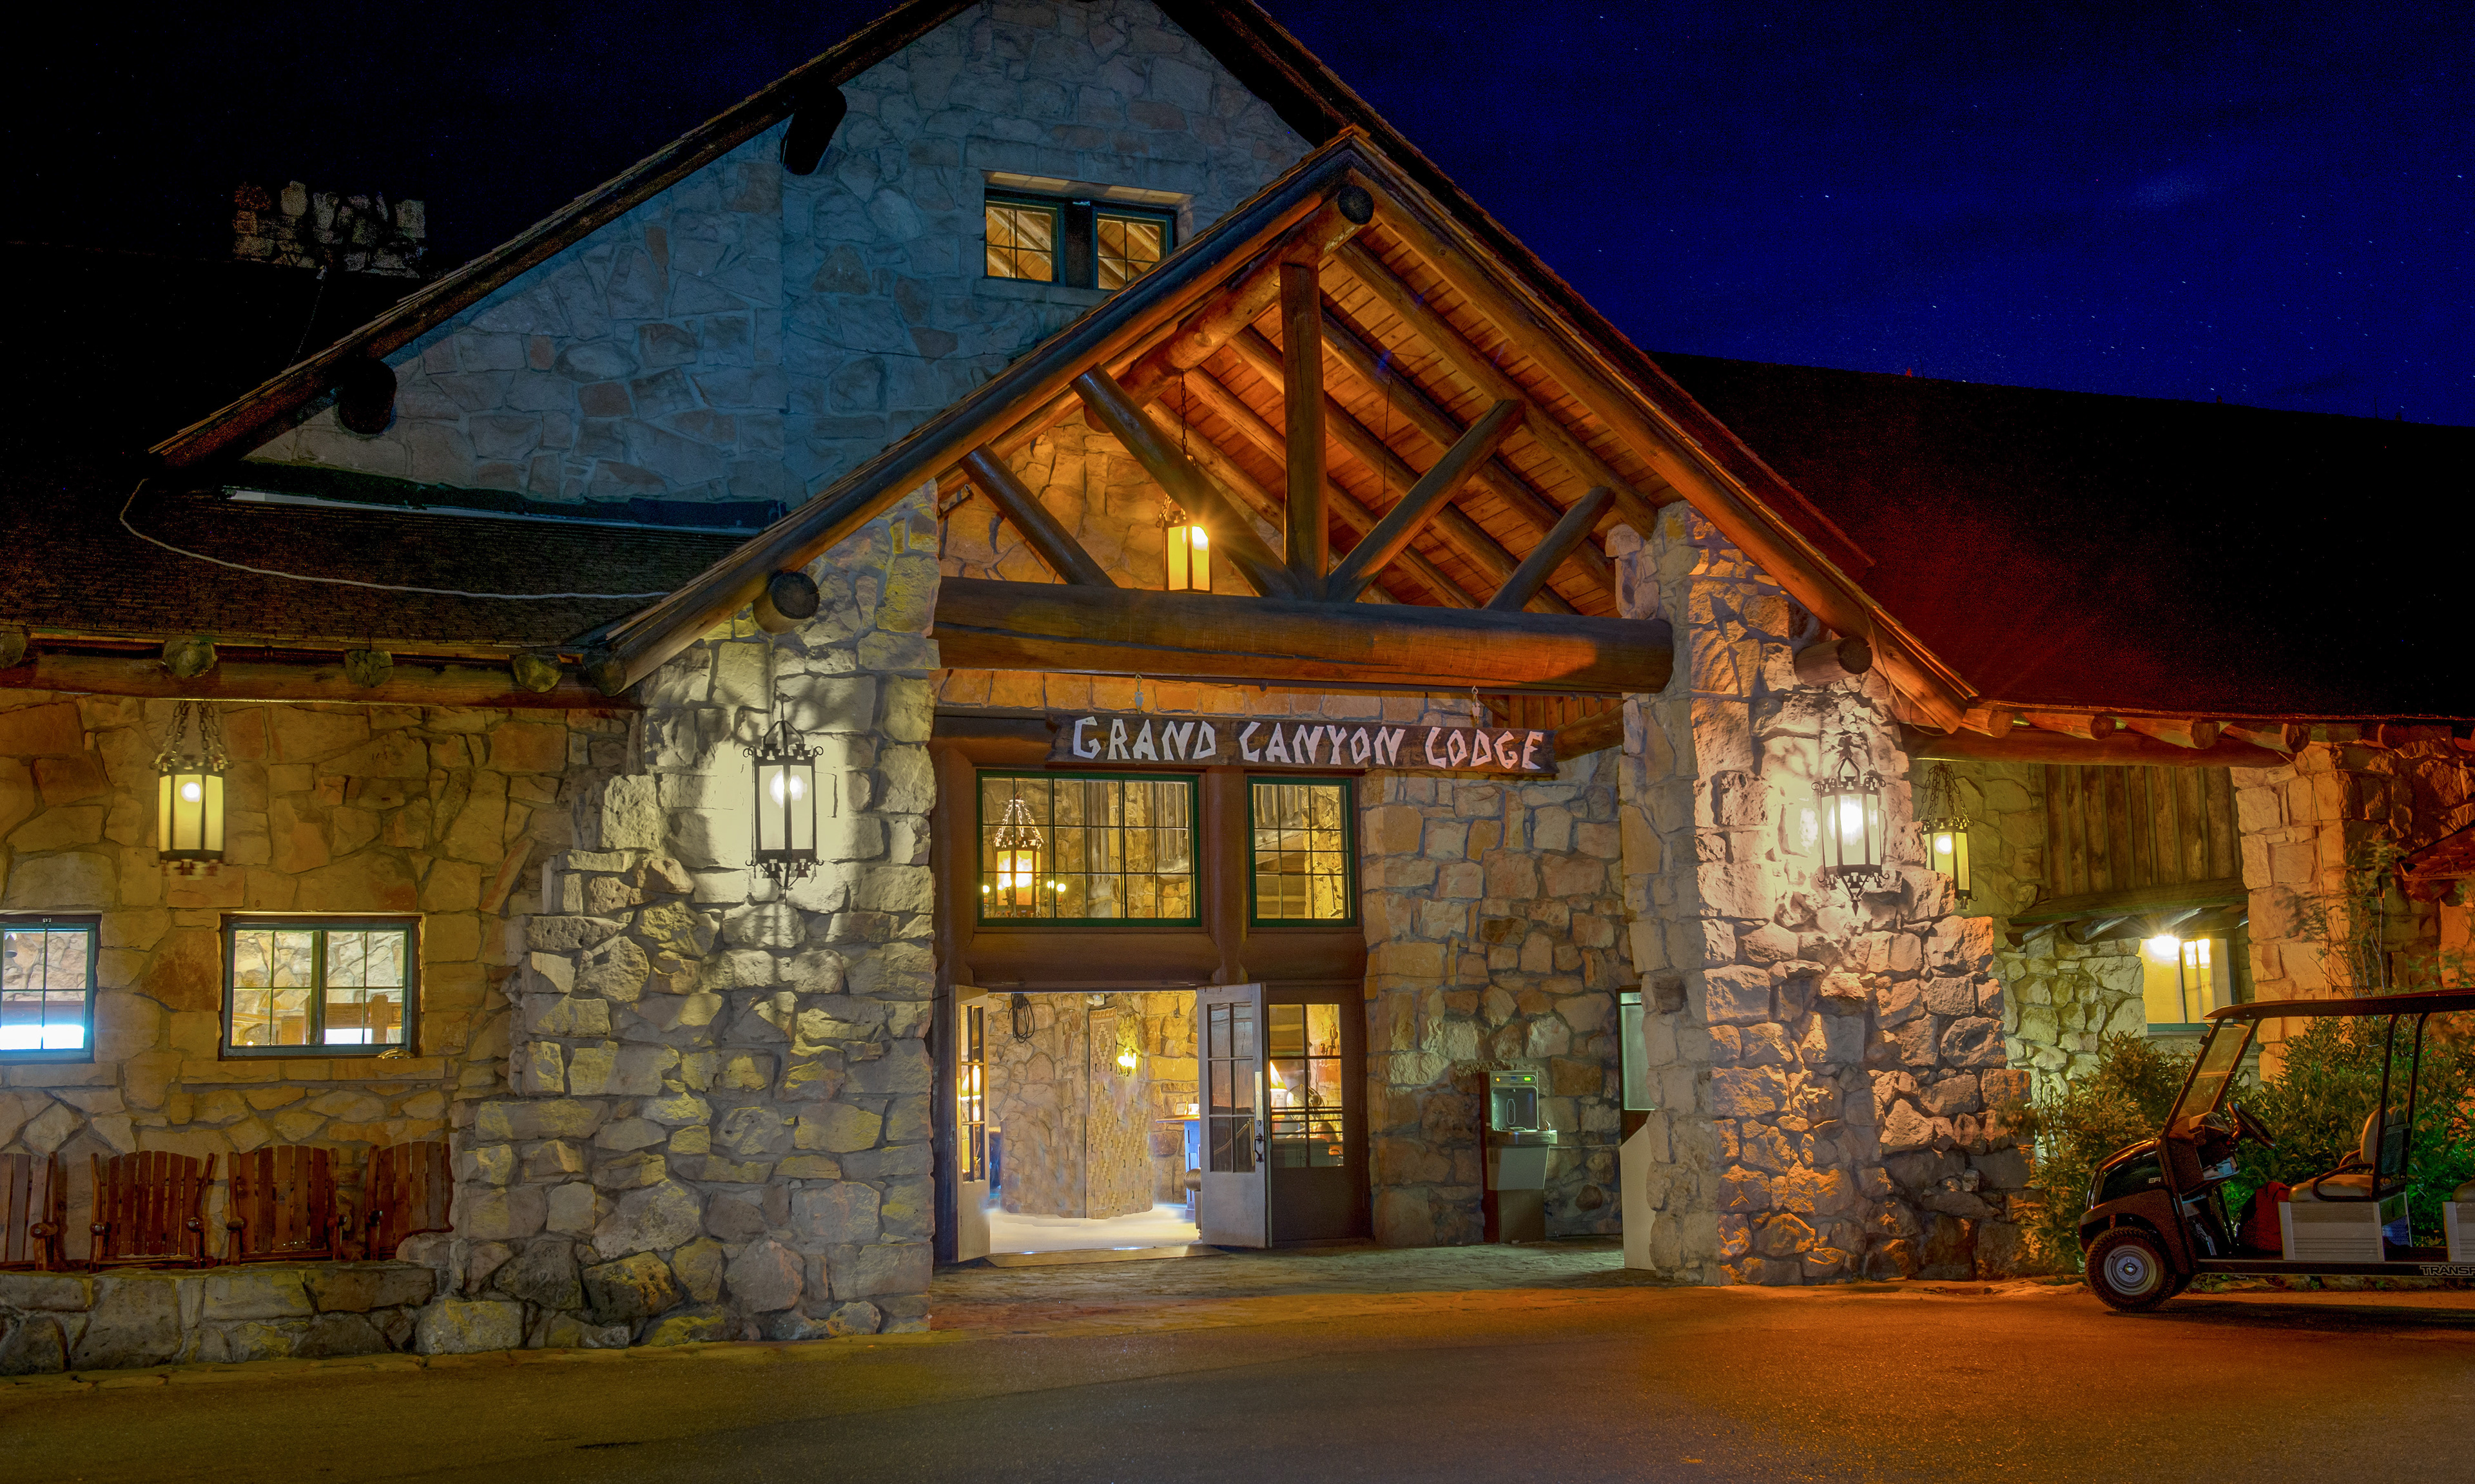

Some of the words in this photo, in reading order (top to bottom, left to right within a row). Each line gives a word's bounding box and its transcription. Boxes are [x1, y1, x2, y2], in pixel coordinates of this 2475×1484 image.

[1073, 716, 1216, 761] GRAND
[1238, 721, 1406, 767] CANYON
[1425, 727, 1544, 770] LODGE
